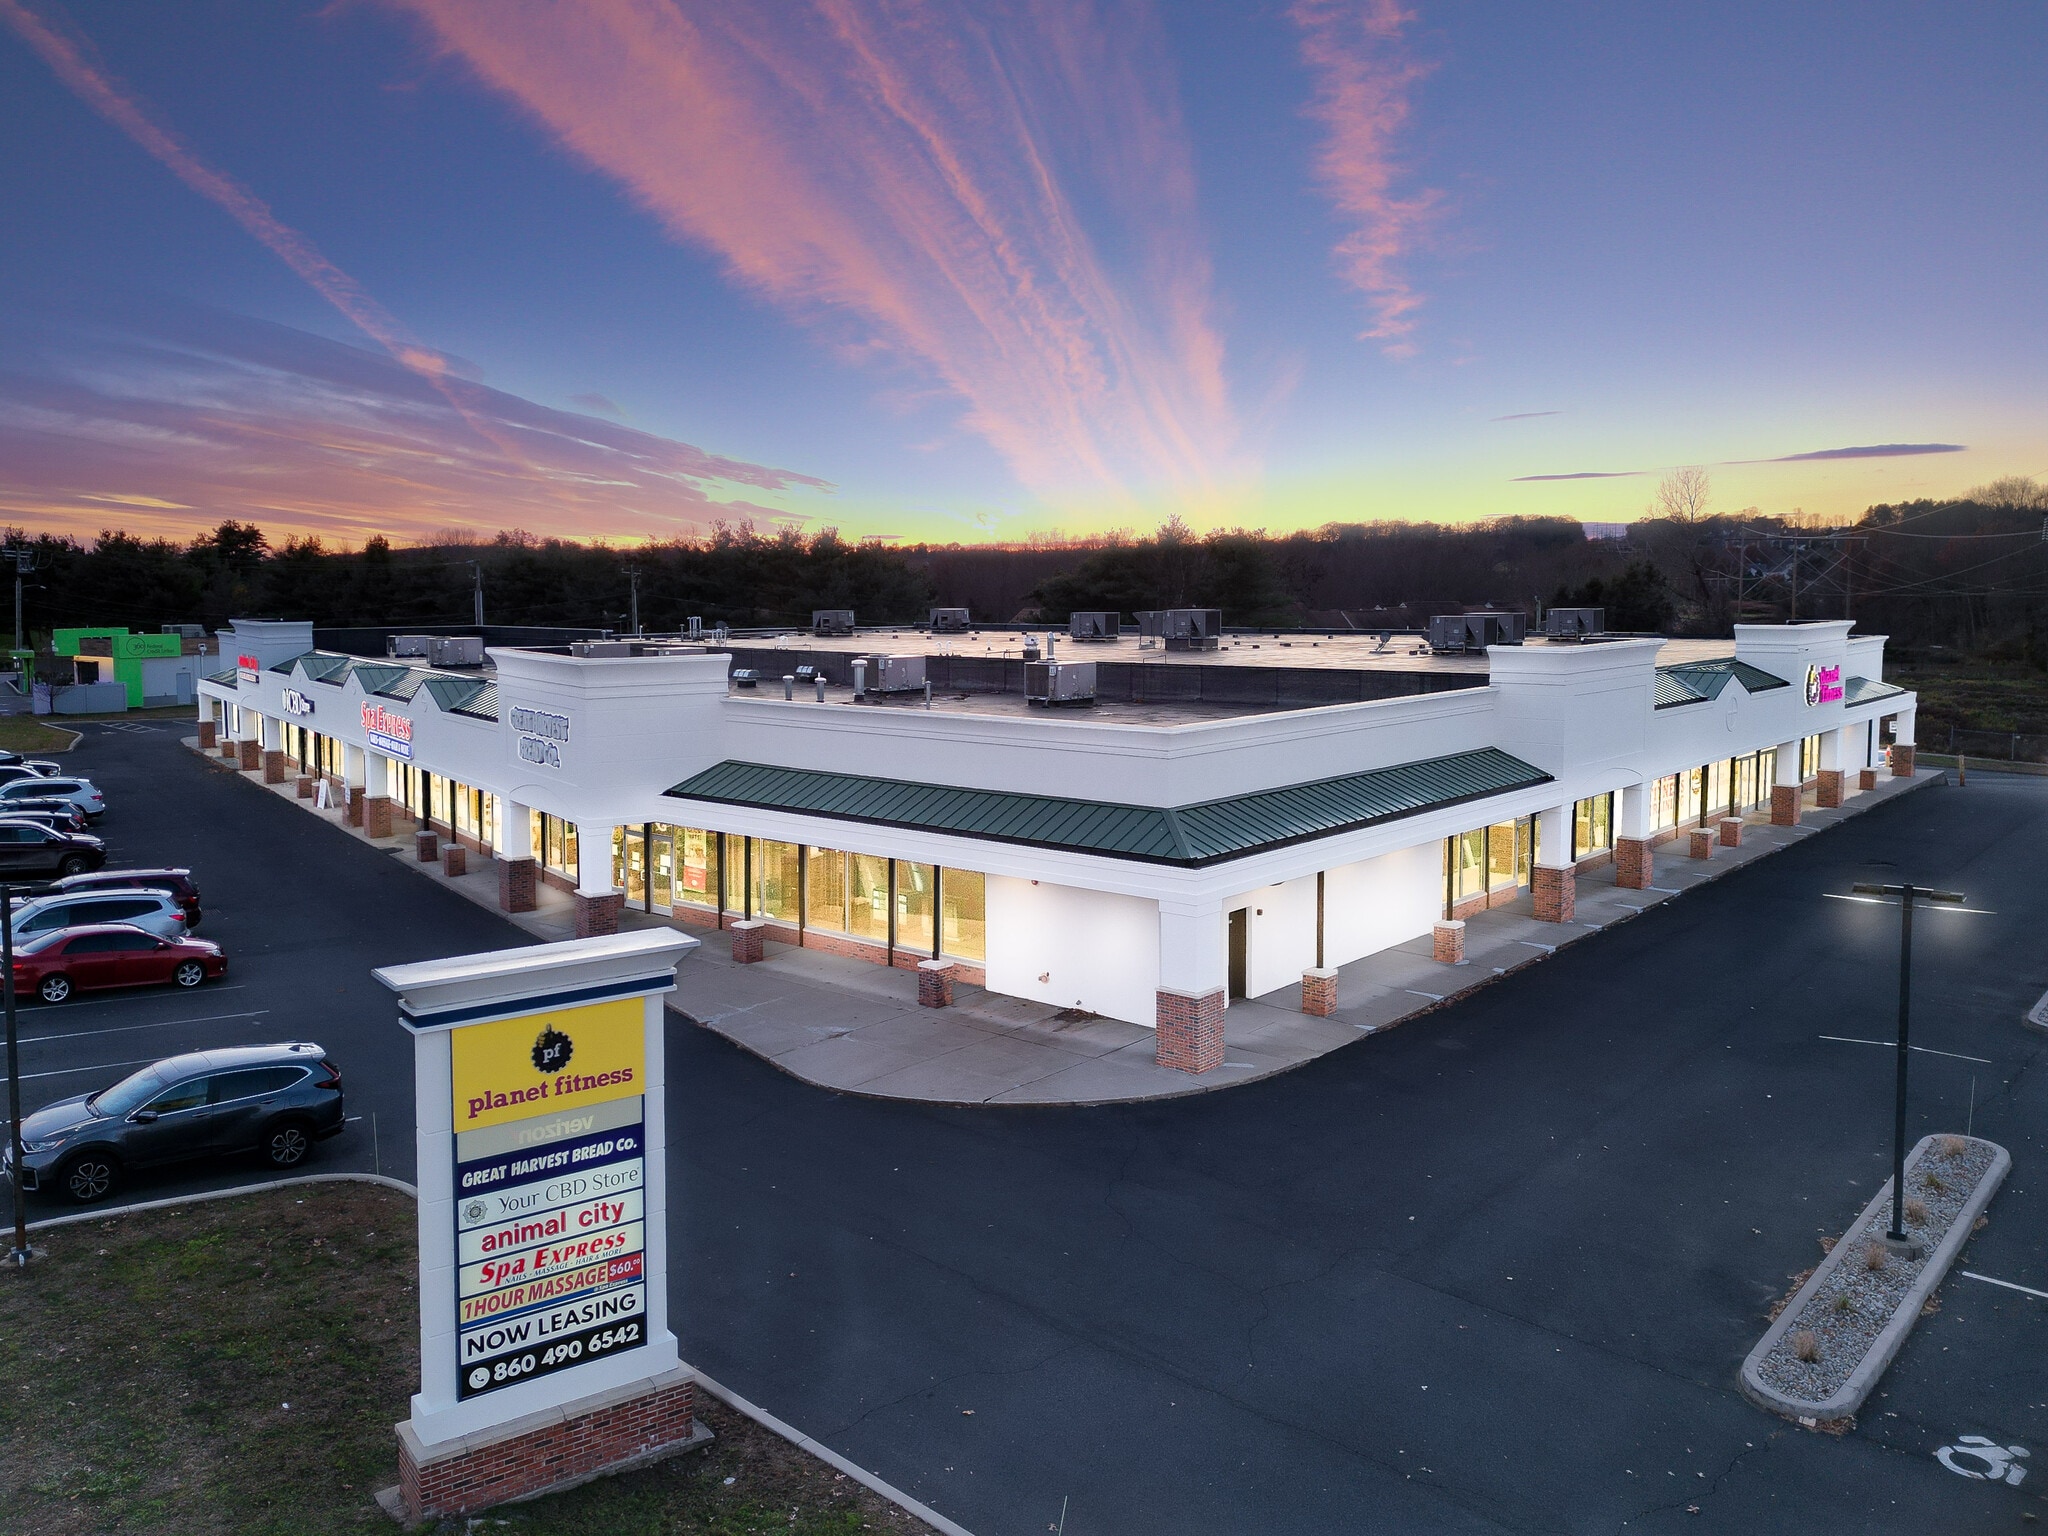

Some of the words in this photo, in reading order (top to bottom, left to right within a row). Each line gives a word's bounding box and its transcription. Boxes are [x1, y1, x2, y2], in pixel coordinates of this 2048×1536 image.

[361, 700, 377, 737] Spa
[542, 1043, 561, 1063] pf
[468, 1081, 549, 1119] planet
[554, 1067, 633, 1096] fitness
[462, 1165, 507, 1188] GREAT
[511, 1151, 569, 1177] HARVEST
[572, 1140, 613, 1163] BREAD
[498, 1192, 540, 1214] Your
[545, 1178, 587, 1202] CBD
[592, 1168, 638, 1191] Store
[481, 1212, 567, 1252] animal
[578, 1201, 625, 1228] city
[479, 1257, 525, 1287] Spa
[505, 1273, 527, 1285] NAILS
[534, 1262, 569, 1276] MASSAGE
[575, 1255, 594, 1266] HAIR
[602, 1247, 622, 1259] MORE
[527, 1265, 607, 1302] MASSAGE
[466, 1321, 531, 1357] NOW
[538, 1293, 636, 1336] LEASING
[493, 1354, 536, 1381] 860
[541, 1340, 583, 1366] 490
[588, 1323, 639, 1352] 6542
